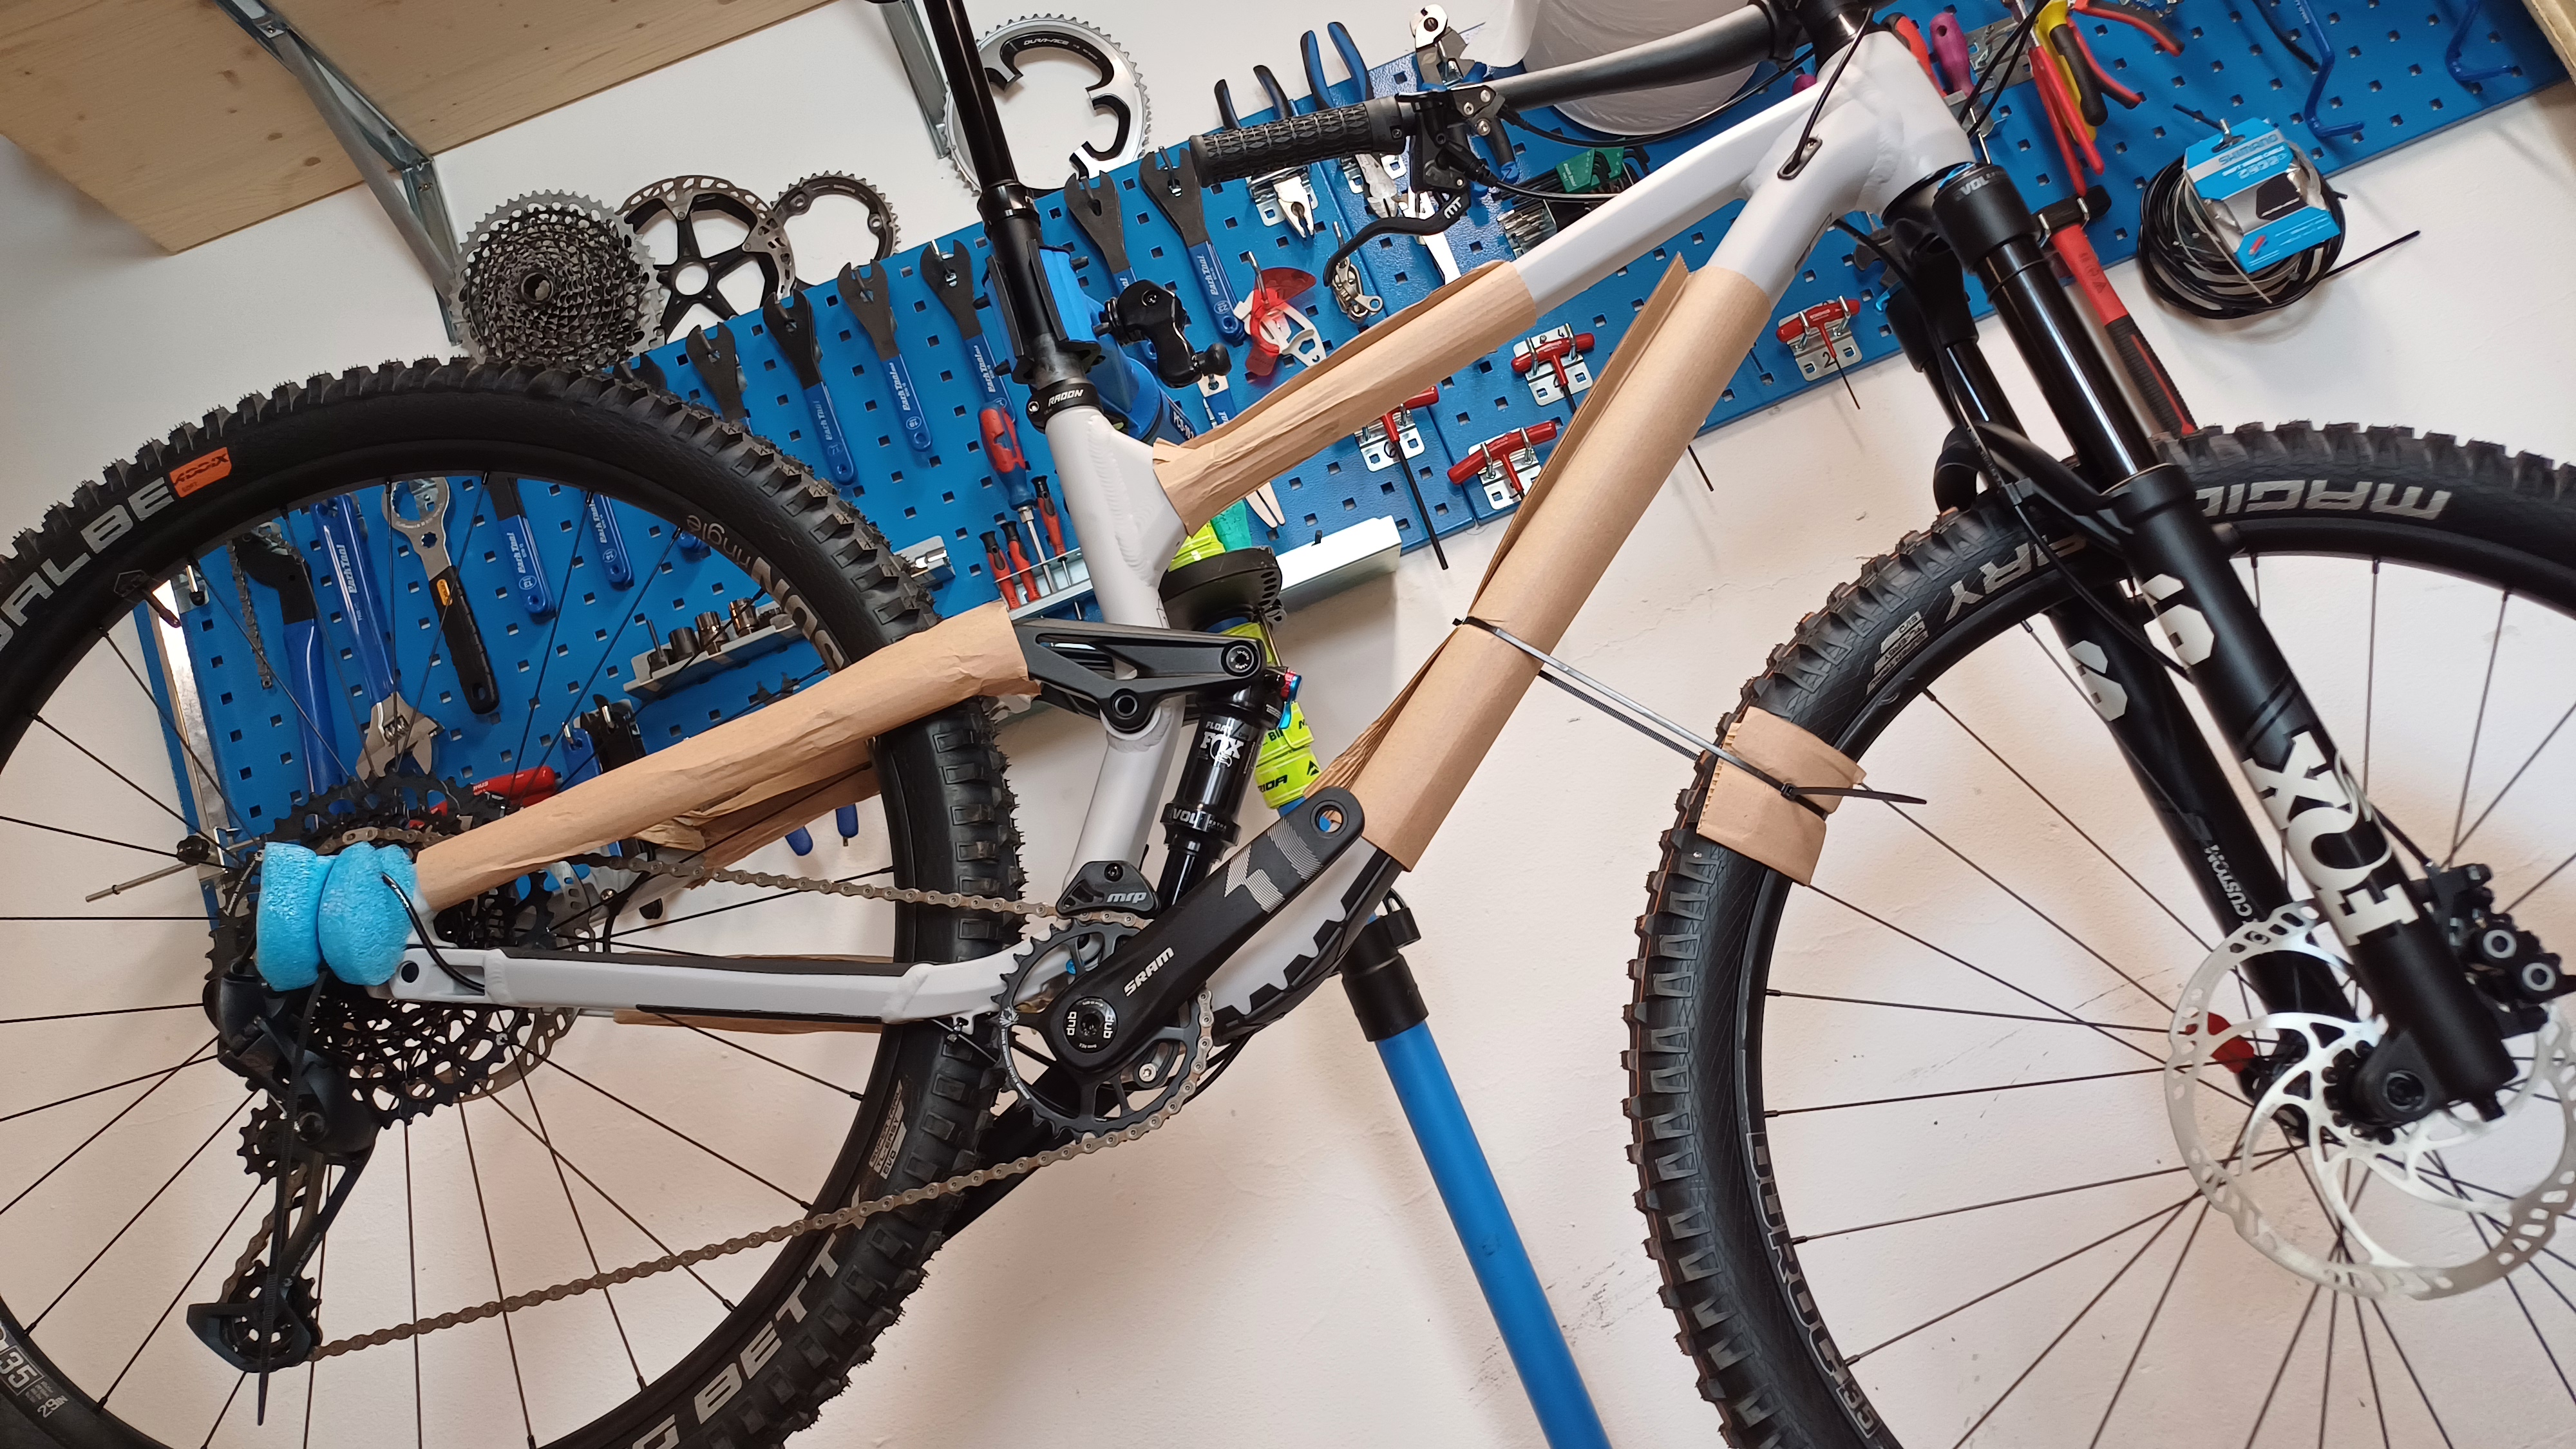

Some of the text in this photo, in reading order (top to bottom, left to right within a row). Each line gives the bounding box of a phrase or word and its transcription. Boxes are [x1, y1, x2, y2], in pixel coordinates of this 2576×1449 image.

[1023, 37, 1069, 46] DURA-ACE
[2219, 133, 2278, 166] SHIMANO
[1444, 196, 1463, 220] MT
[1197, 253, 1218, 297] Park Tool
[974, 352, 996, 393] Park Tool
[1823, 351, 1839, 369] 2
[889, 369, 911, 412] Park Tool
[1048, 389, 1084, 406] RADON
[820, 419, 832, 440] Park
[175, 453, 229, 486] ADDIX
[594, 522, 607, 544] Park
[336, 542, 357, 594] Park Tool
[506, 531, 526, 574] Park Tool
[687, 515, 844, 674] SUN ringlé
[1899, 614, 1918, 632] EVO
[1200, 732, 1245, 768] FOX
[2242, 730, 2420, 947] FOX
[2204, 844, 2253, 916] CUSTOM
[1107, 890, 1147, 904] mrp
[1124, 947, 1174, 998] SRAM
[1066, 1011, 1077, 1037] dub
[1103, 1013, 1114, 1039] dub
[883, 1149, 897, 1175] EVO
[1747, 1132, 1874, 1428] DUROC 35
